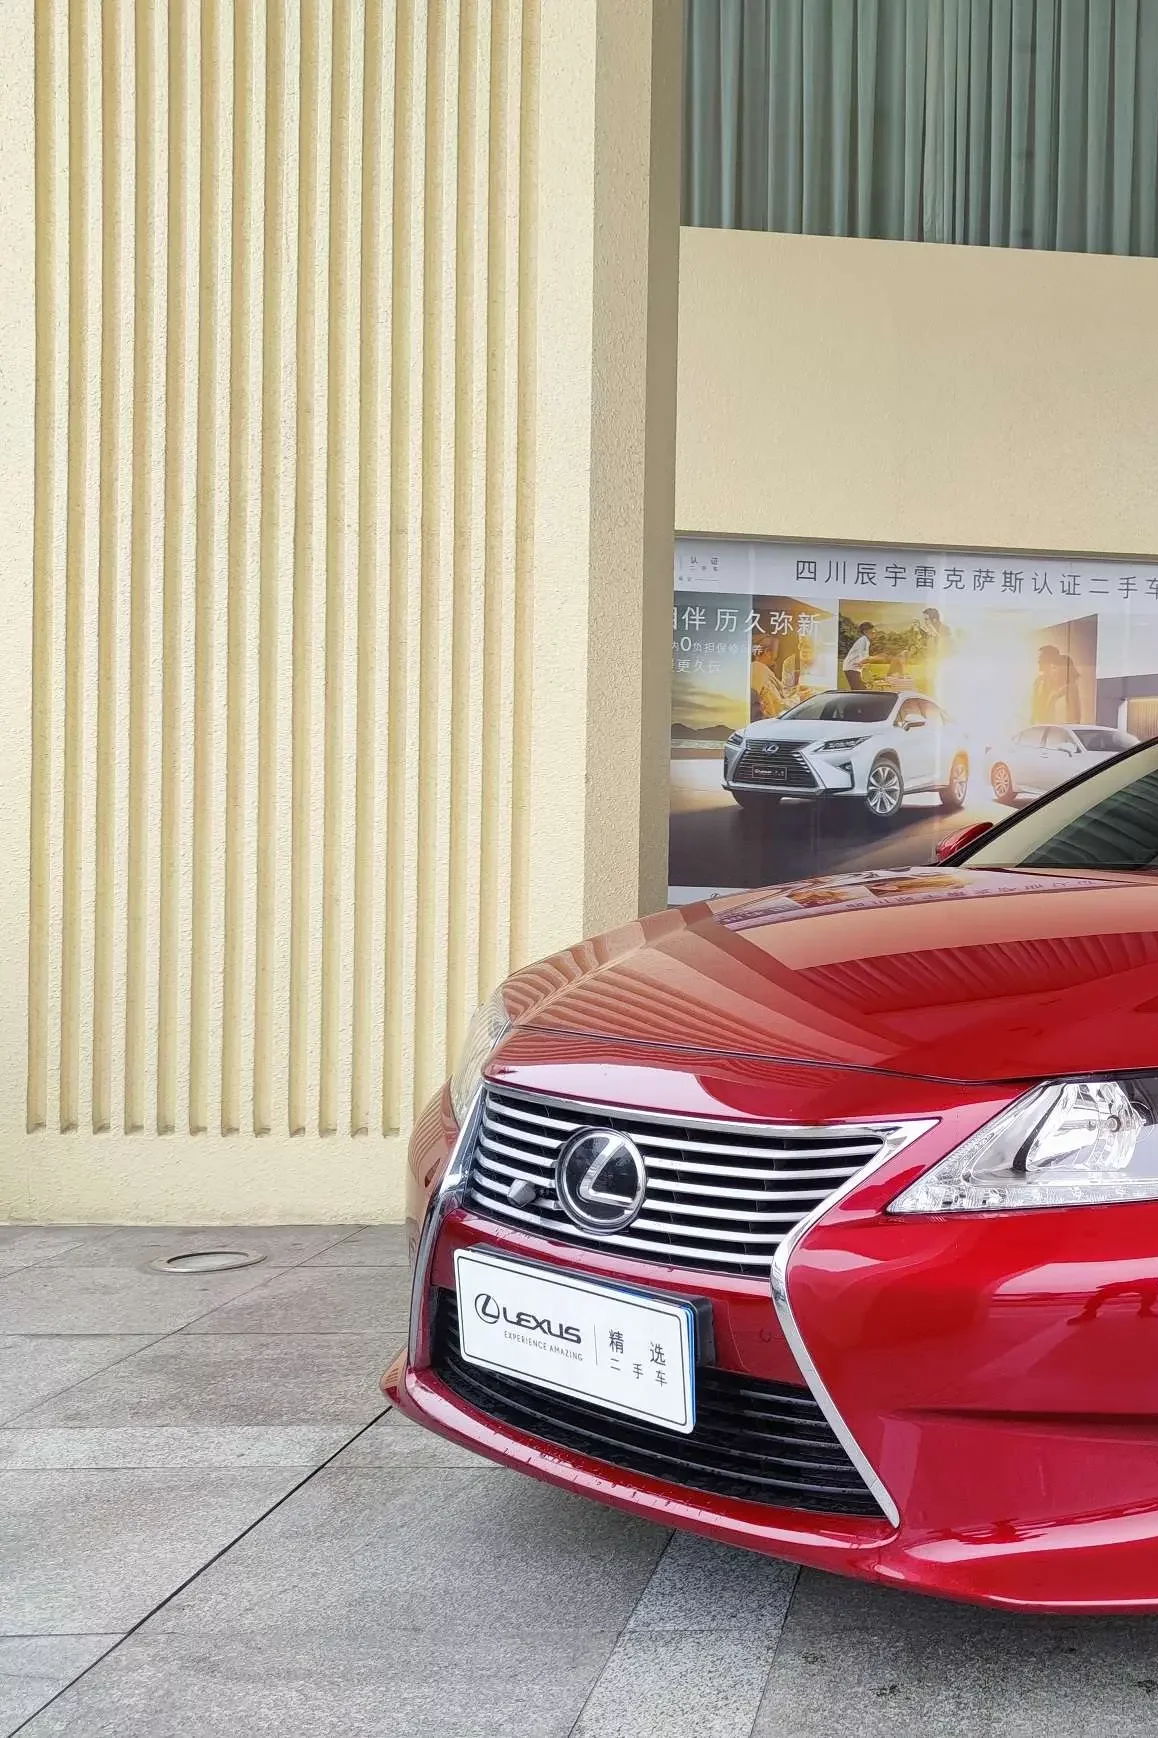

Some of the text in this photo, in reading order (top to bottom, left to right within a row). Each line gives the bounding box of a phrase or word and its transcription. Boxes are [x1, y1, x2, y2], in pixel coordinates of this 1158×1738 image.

[714, 608, 821, 637] 历久弥新
[502, 1306, 582, 1344] LEXUS
[504, 1330, 584, 1361] EXPERIENCE AMAZING
[608, 1328, 667, 1366] 精选
[609, 1357, 668, 1388] 二手车
